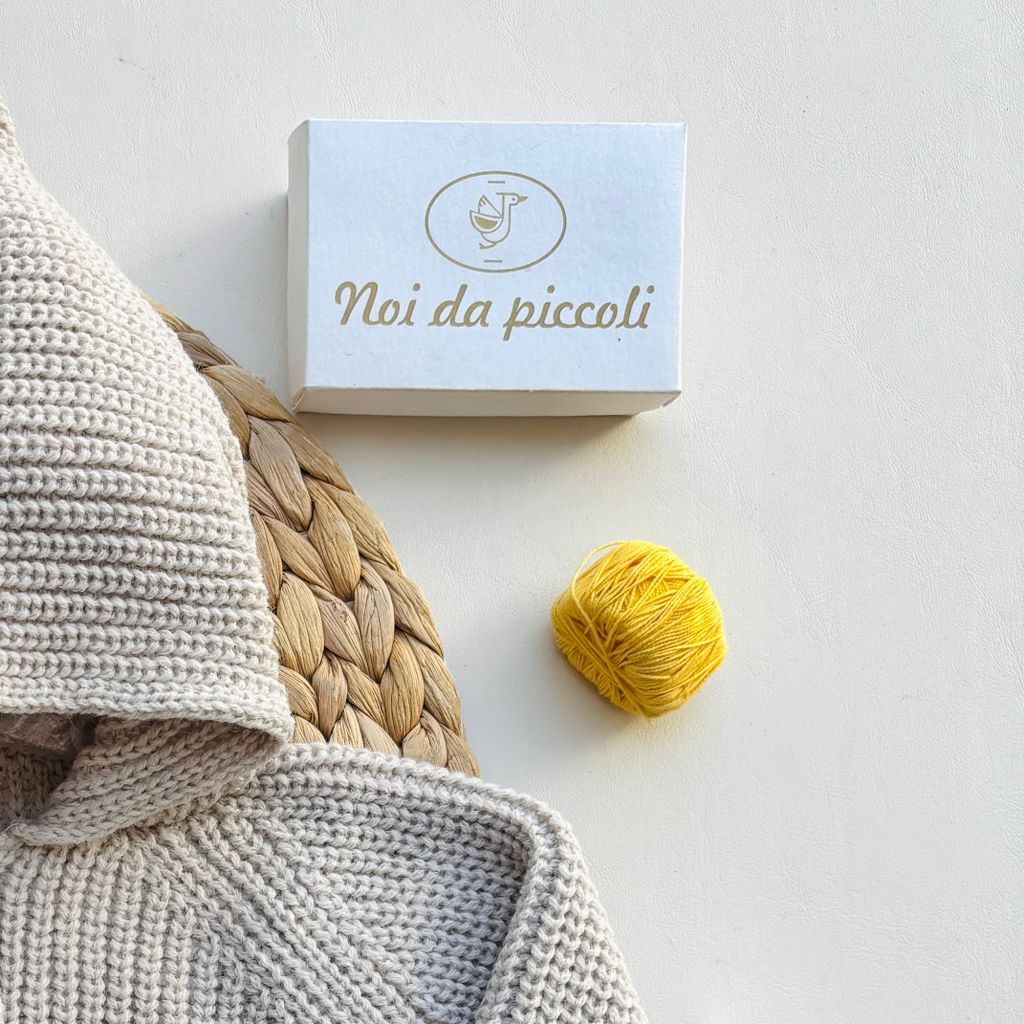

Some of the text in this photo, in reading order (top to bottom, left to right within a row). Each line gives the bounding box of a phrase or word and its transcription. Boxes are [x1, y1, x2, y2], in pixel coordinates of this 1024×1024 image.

[334, 281, 656, 342] Noi da piccoli
